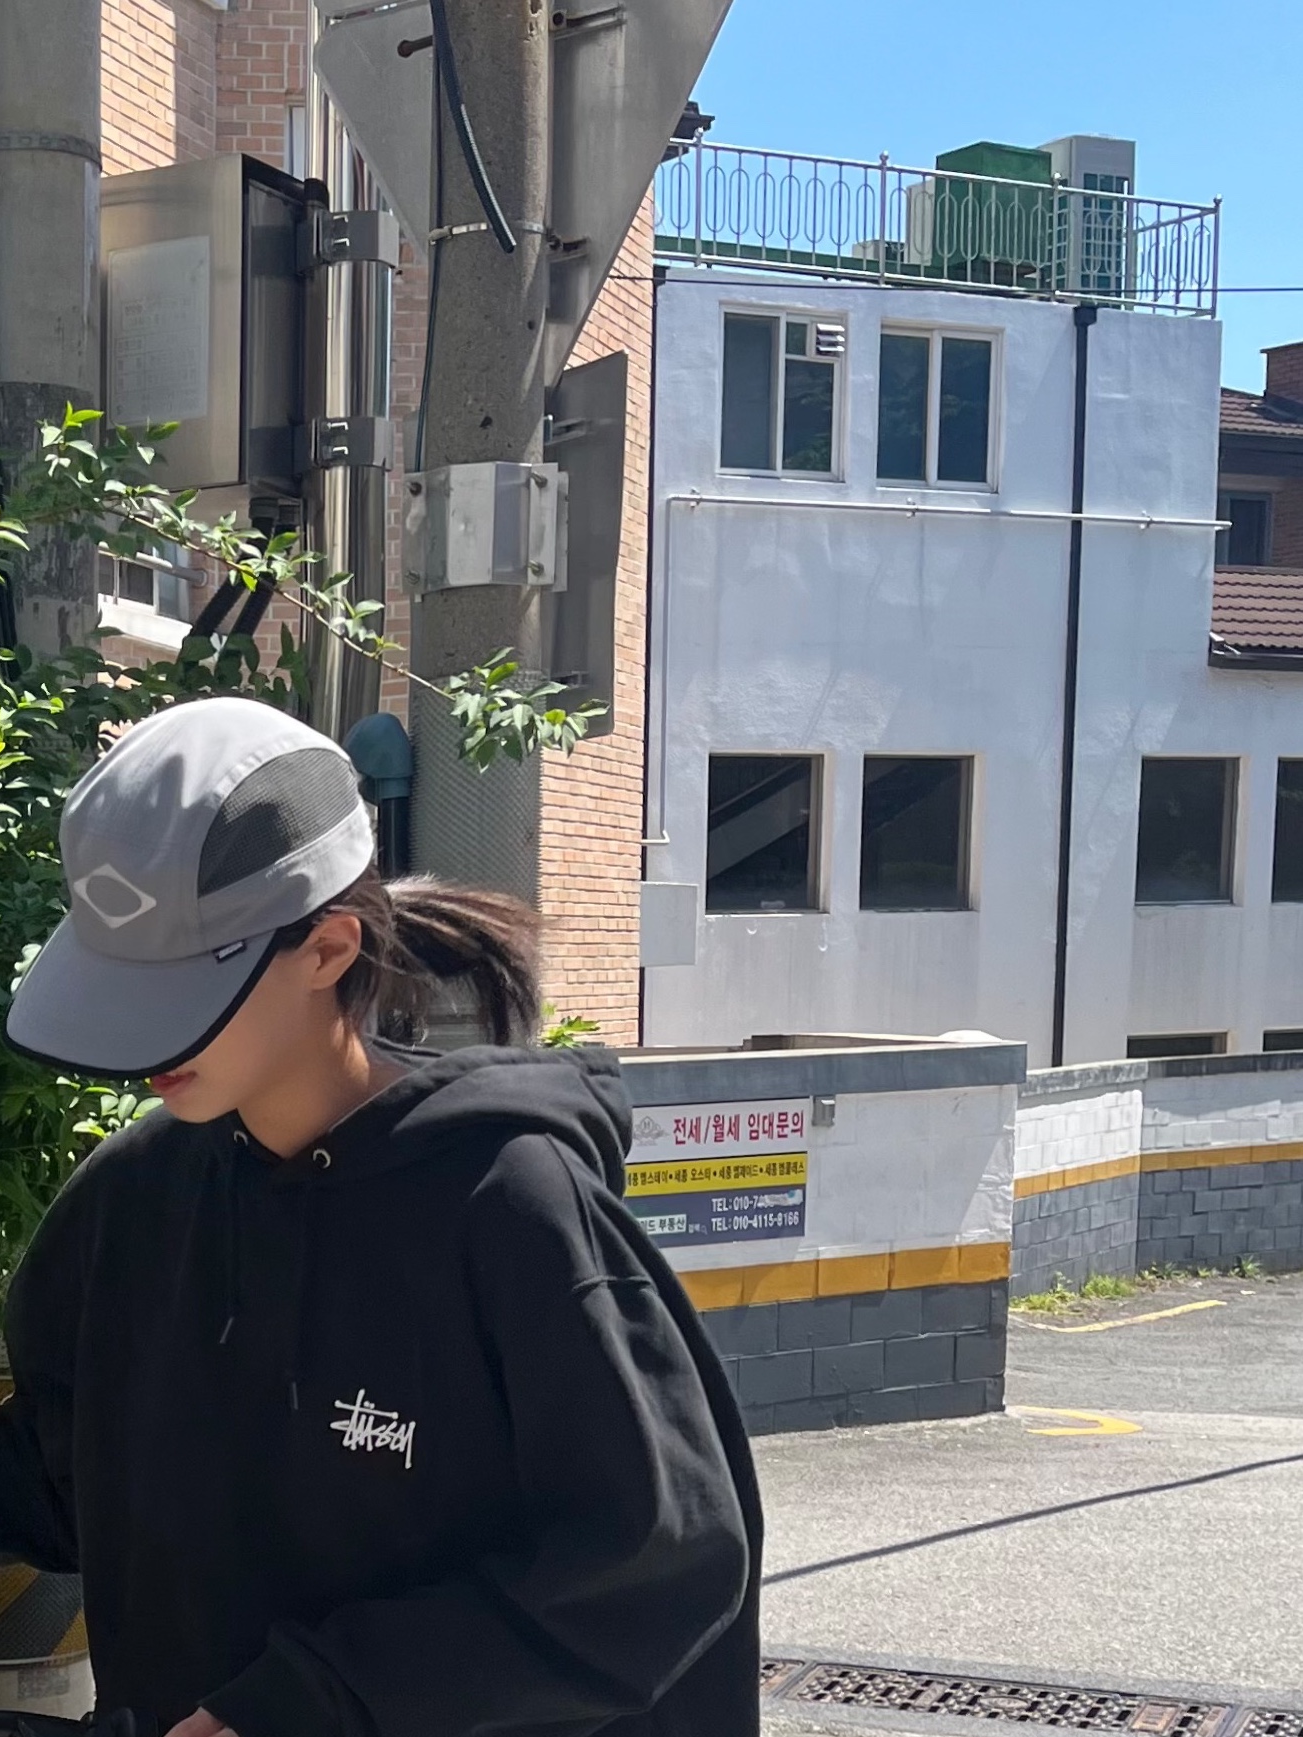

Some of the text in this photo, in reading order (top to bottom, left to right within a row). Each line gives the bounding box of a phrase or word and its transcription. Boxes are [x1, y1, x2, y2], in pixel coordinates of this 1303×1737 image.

[673, 1109, 804, 1145] 전세/월세 임대문의
[659, 1217, 685, 1232] 부동산
